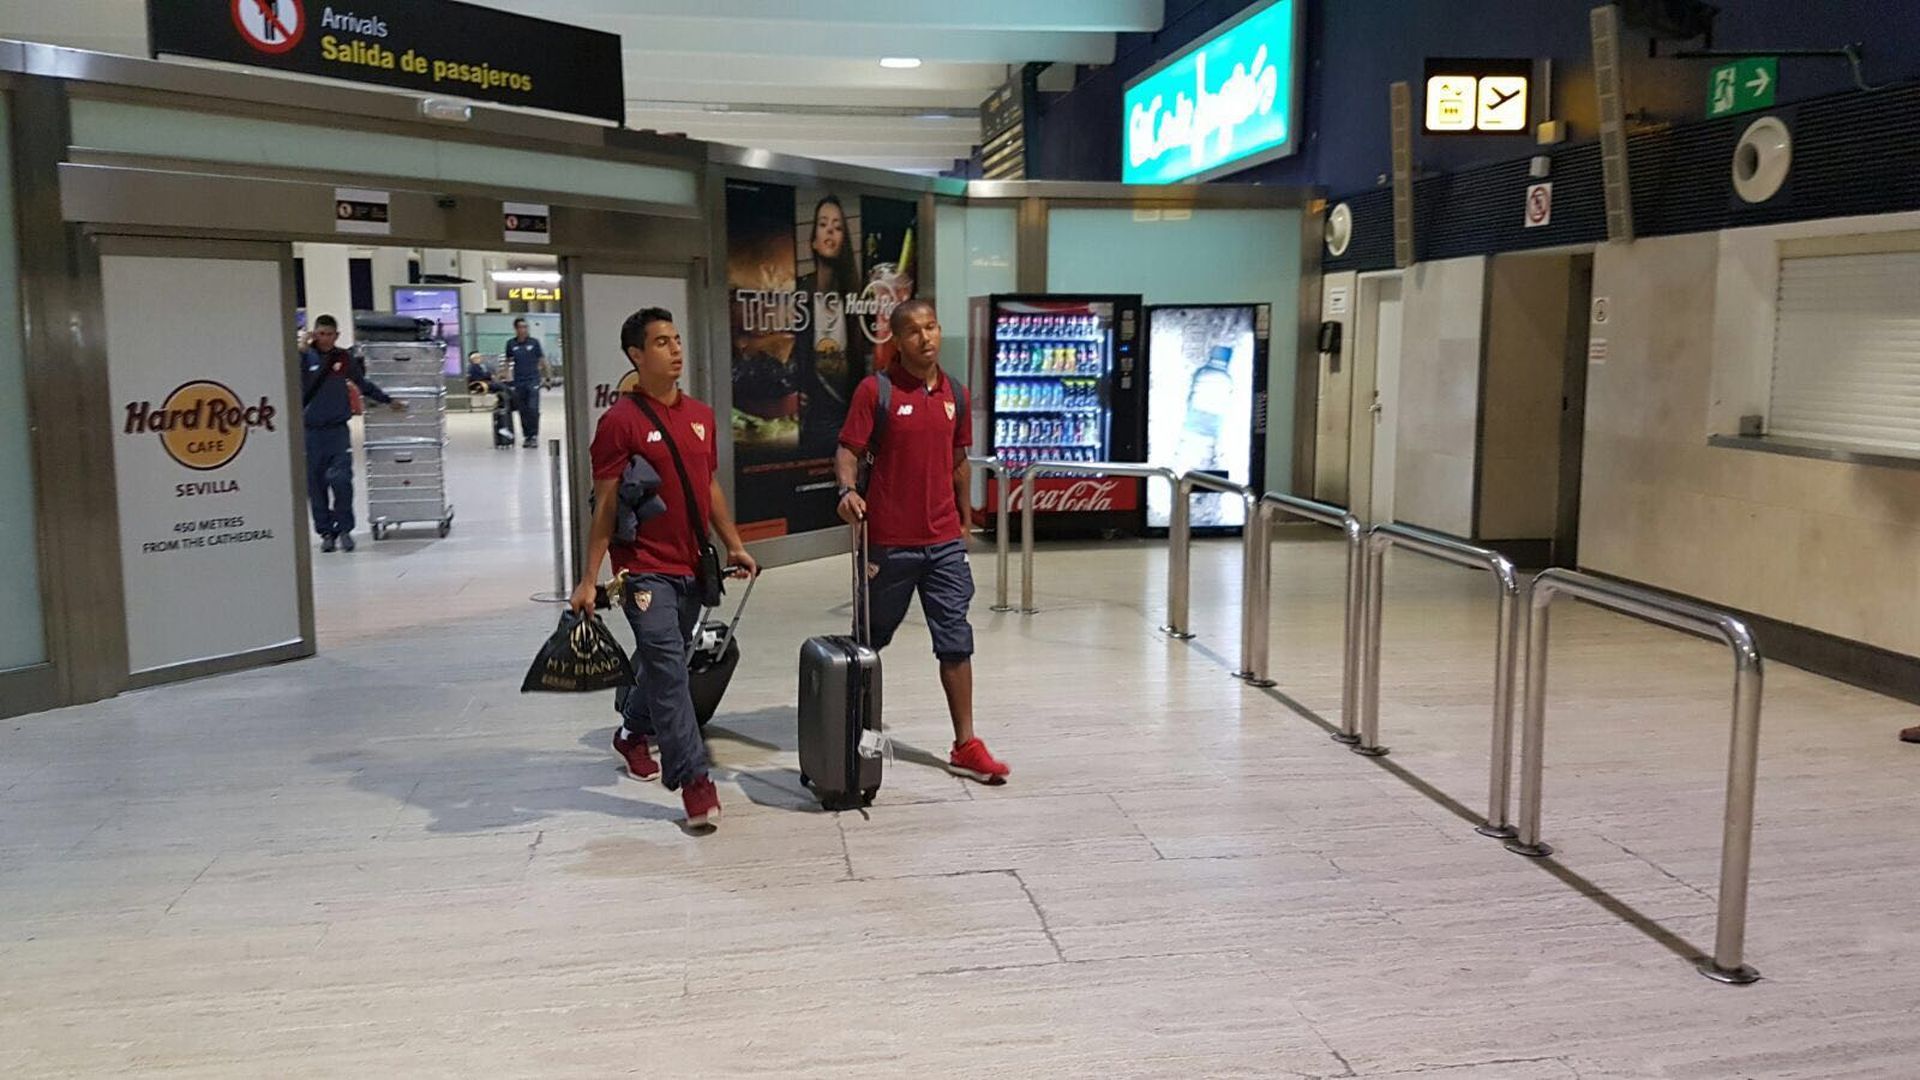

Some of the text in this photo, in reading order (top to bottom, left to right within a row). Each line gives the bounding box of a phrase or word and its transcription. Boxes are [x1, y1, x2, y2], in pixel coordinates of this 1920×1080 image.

[321, 6, 389, 38] Arrivals
[321, 35, 533, 91] Salida de pasajeros
[736, 289, 840, 333] THIS IS
[845, 292, 879, 315] Hard
[123, 396, 276, 435] Hard Rock
[186, 439, 227, 455] CAFE
[175, 479, 241, 498] SEVILLA
[172, 516, 245, 533] 450 METRES
[142, 529, 275, 554] FROM THE CATHEDRAL
